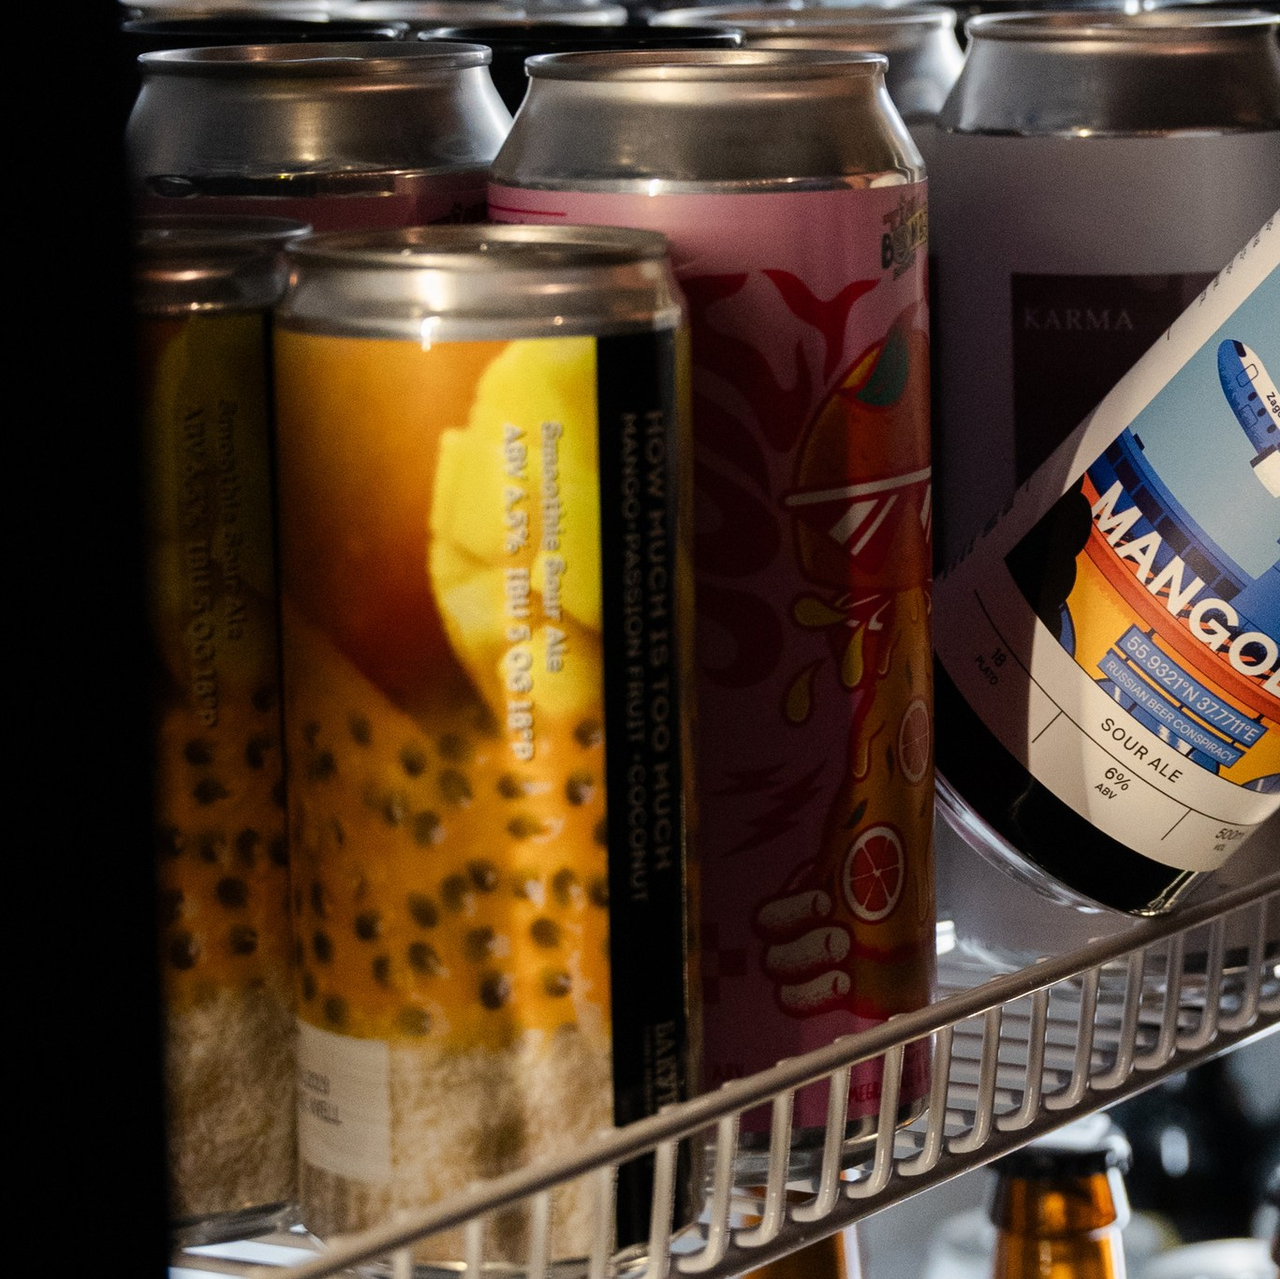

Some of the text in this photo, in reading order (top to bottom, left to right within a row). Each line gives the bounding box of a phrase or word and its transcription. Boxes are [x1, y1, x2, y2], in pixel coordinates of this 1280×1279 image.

[1023, 307, 1134, 331] KARMA
[502, 423, 527, 479] ABV
[540, 420, 568, 673] Smoothie Sour Ale
[506, 567, 531, 618] IBU
[643, 409, 673, 871] HOW MUCH IS TOO MUCH
[991, 647, 1007, 668] 18
[506, 651, 533, 692] OG
[975, 655, 998, 686] PLATO
[1126, 635, 1260, 742] 55.9321°N 37.7711°E
[625, 665, 646, 744] FRUIT
[1105, 659, 1237, 763] RUSSIAN BEER CONSPIRACY
[1100, 718, 1184, 784] SOUR ALE
[1094, 783, 1118, 800] ABV
[1104, 767, 1132, 792] 6%
